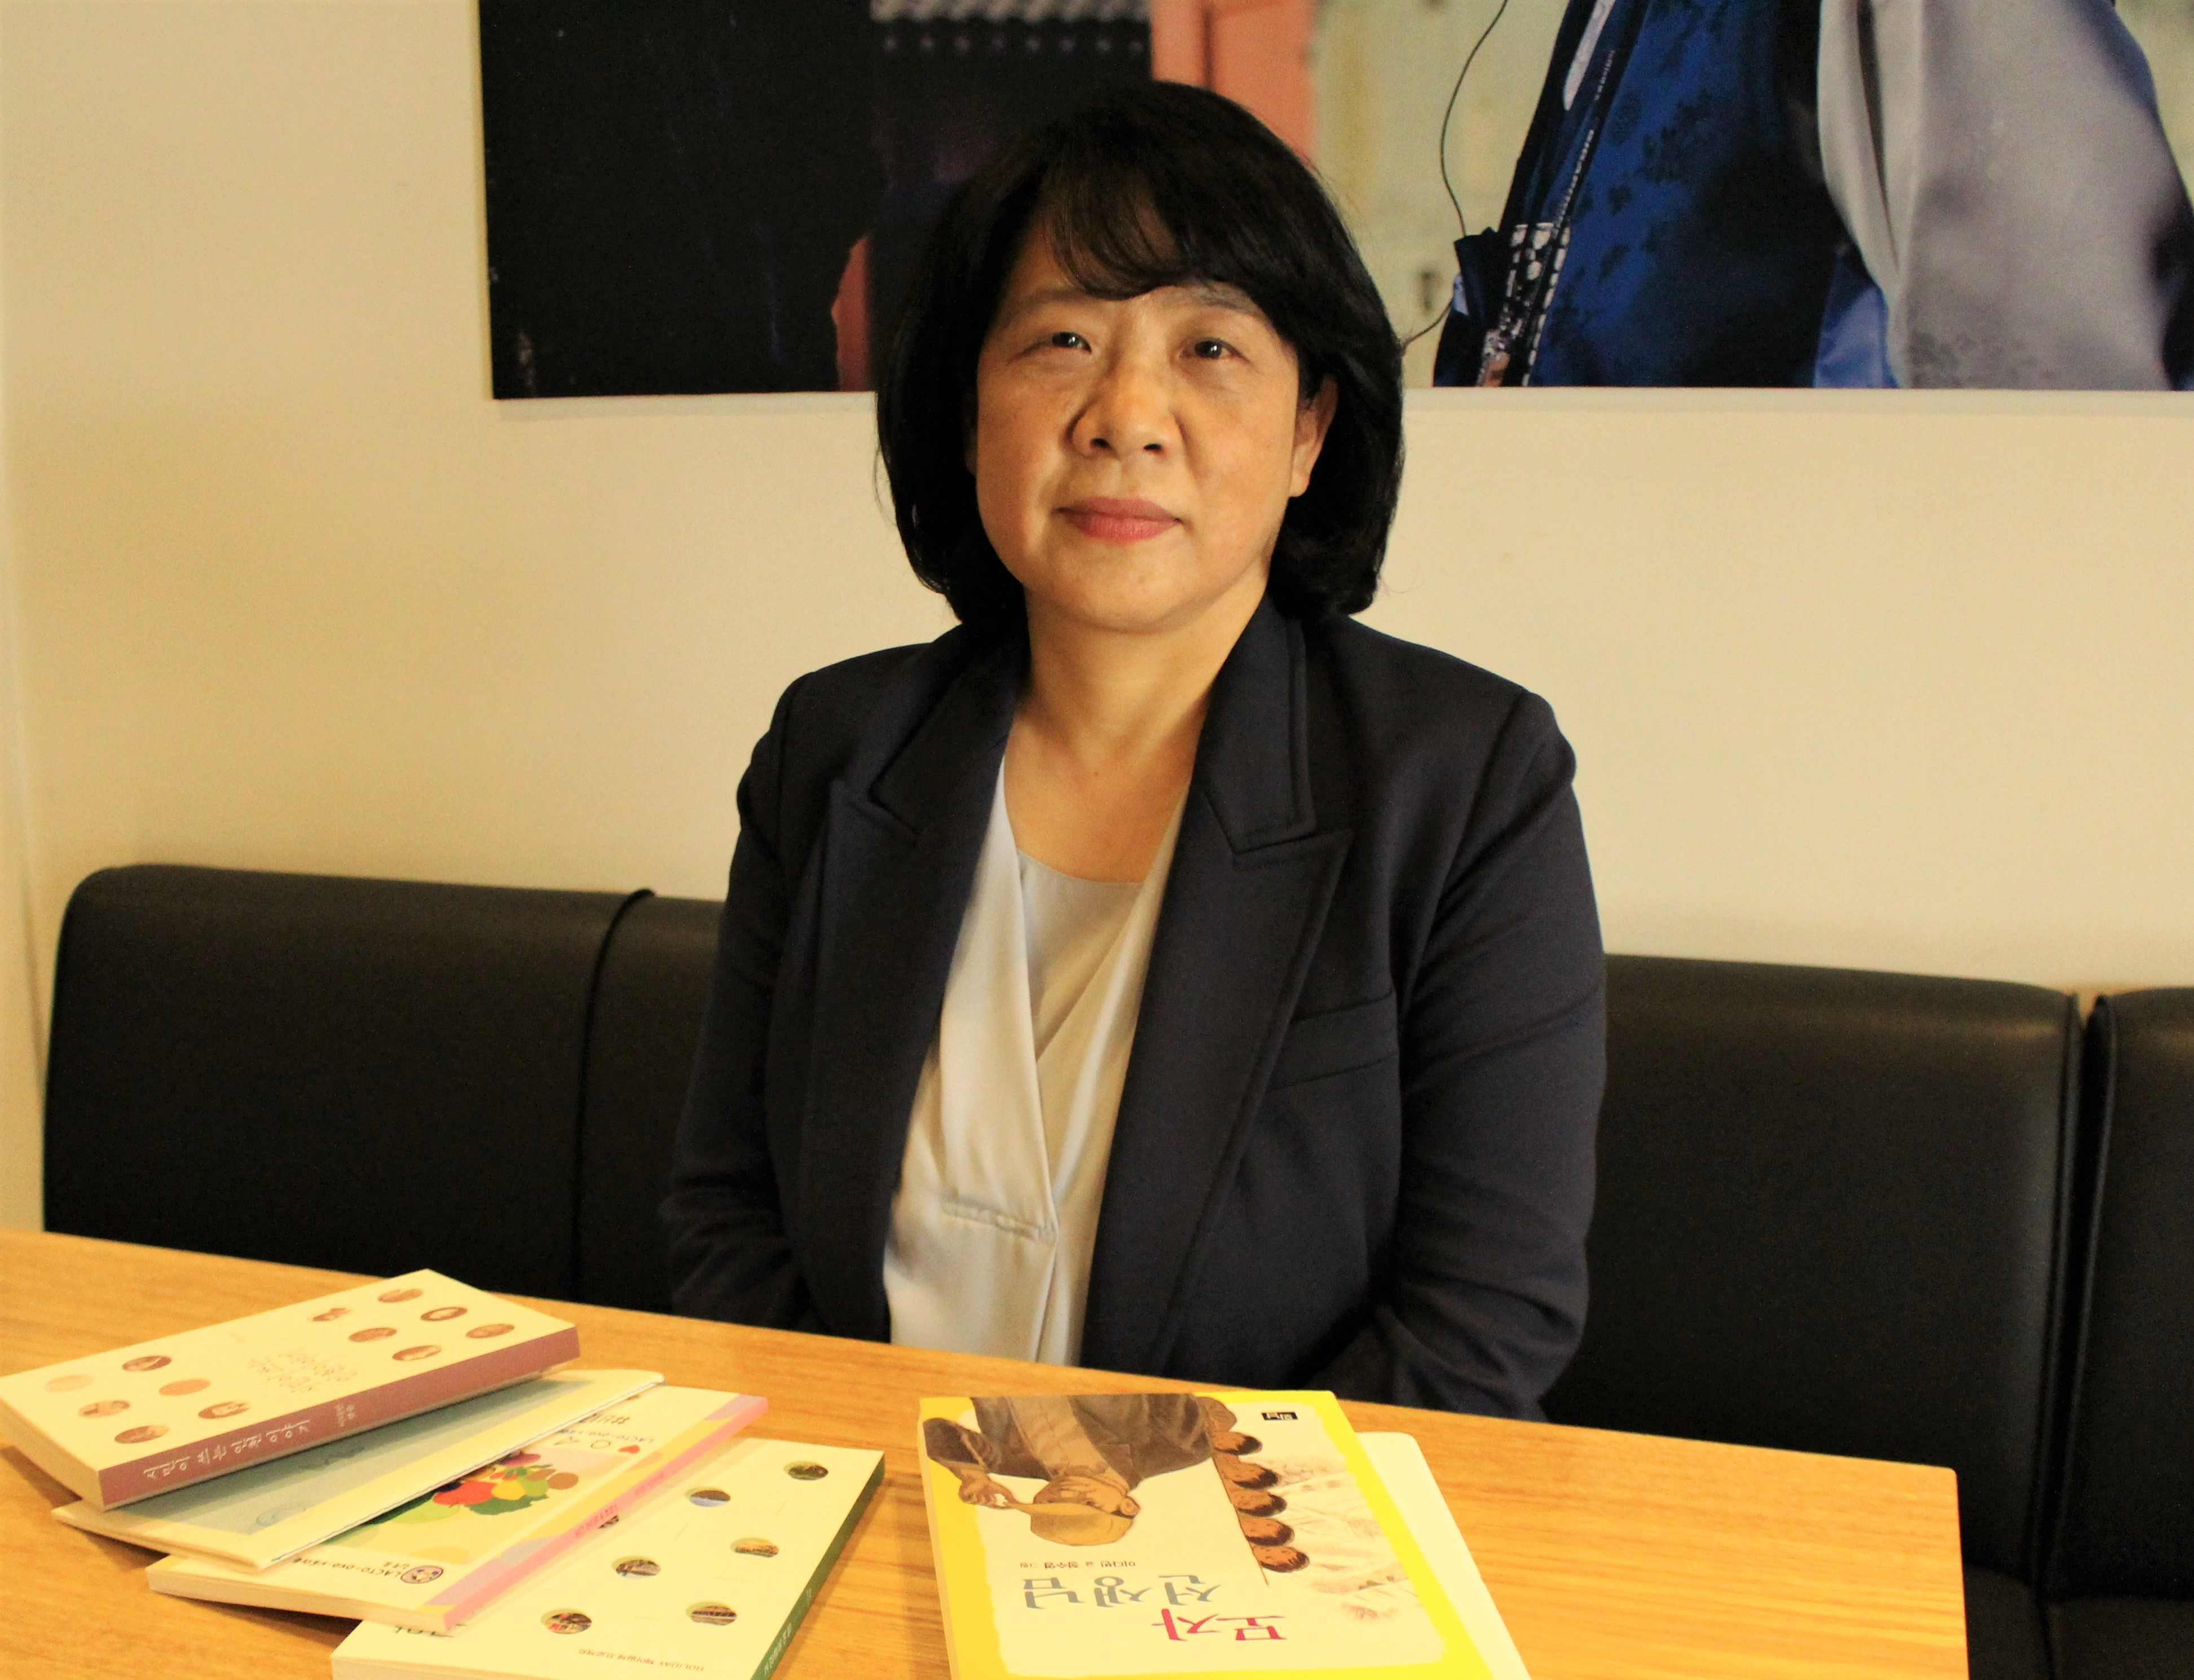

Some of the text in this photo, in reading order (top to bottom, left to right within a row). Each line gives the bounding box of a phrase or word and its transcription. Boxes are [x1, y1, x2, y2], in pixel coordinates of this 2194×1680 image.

[143, 1419, 311, 1479] 시민이 쓰는 인천 이야기
[1022, 1574, 1221, 1609] 선생님
[1151, 1608, 1288, 1641] 모자
[657, 1660, 704, 1672] HOLIDAY
